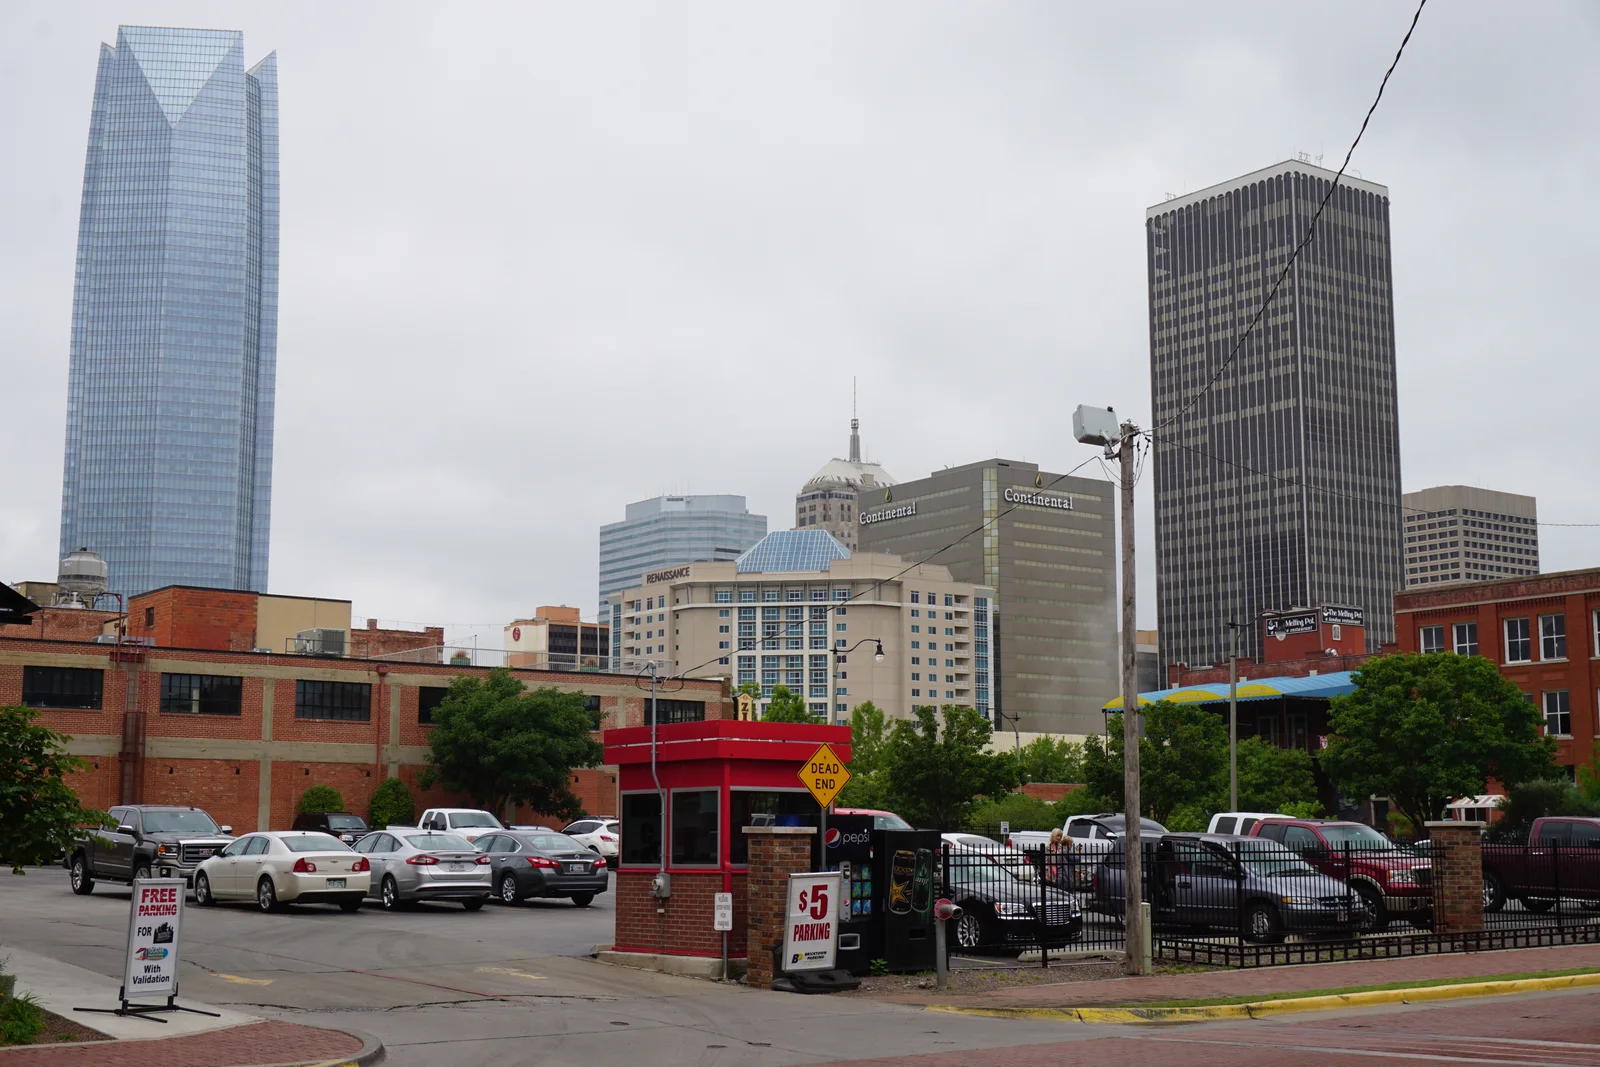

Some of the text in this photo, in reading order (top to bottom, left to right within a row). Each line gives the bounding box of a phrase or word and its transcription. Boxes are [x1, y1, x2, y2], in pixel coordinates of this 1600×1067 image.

[1004, 488, 1074, 510] Continental
[859, 502, 917, 525] Continental
[647, 566, 690, 584] RENAISSANCE
[1285, 618, 1304, 628] Melting
[1304, 617, 1315, 625] Pot
[811, 763, 839, 774] DEAD
[815, 779, 836, 789] END
[842, 831, 870, 845] pepsi
[141, 888, 177, 903] FREE
[799, 884, 828, 920] $5
[138, 904, 177, 916] PARKING
[137, 926, 152, 937] FOR
[793, 922, 830, 942] PARKING
[144, 965, 161, 974] With
[132, 975, 170, 985] Validation
